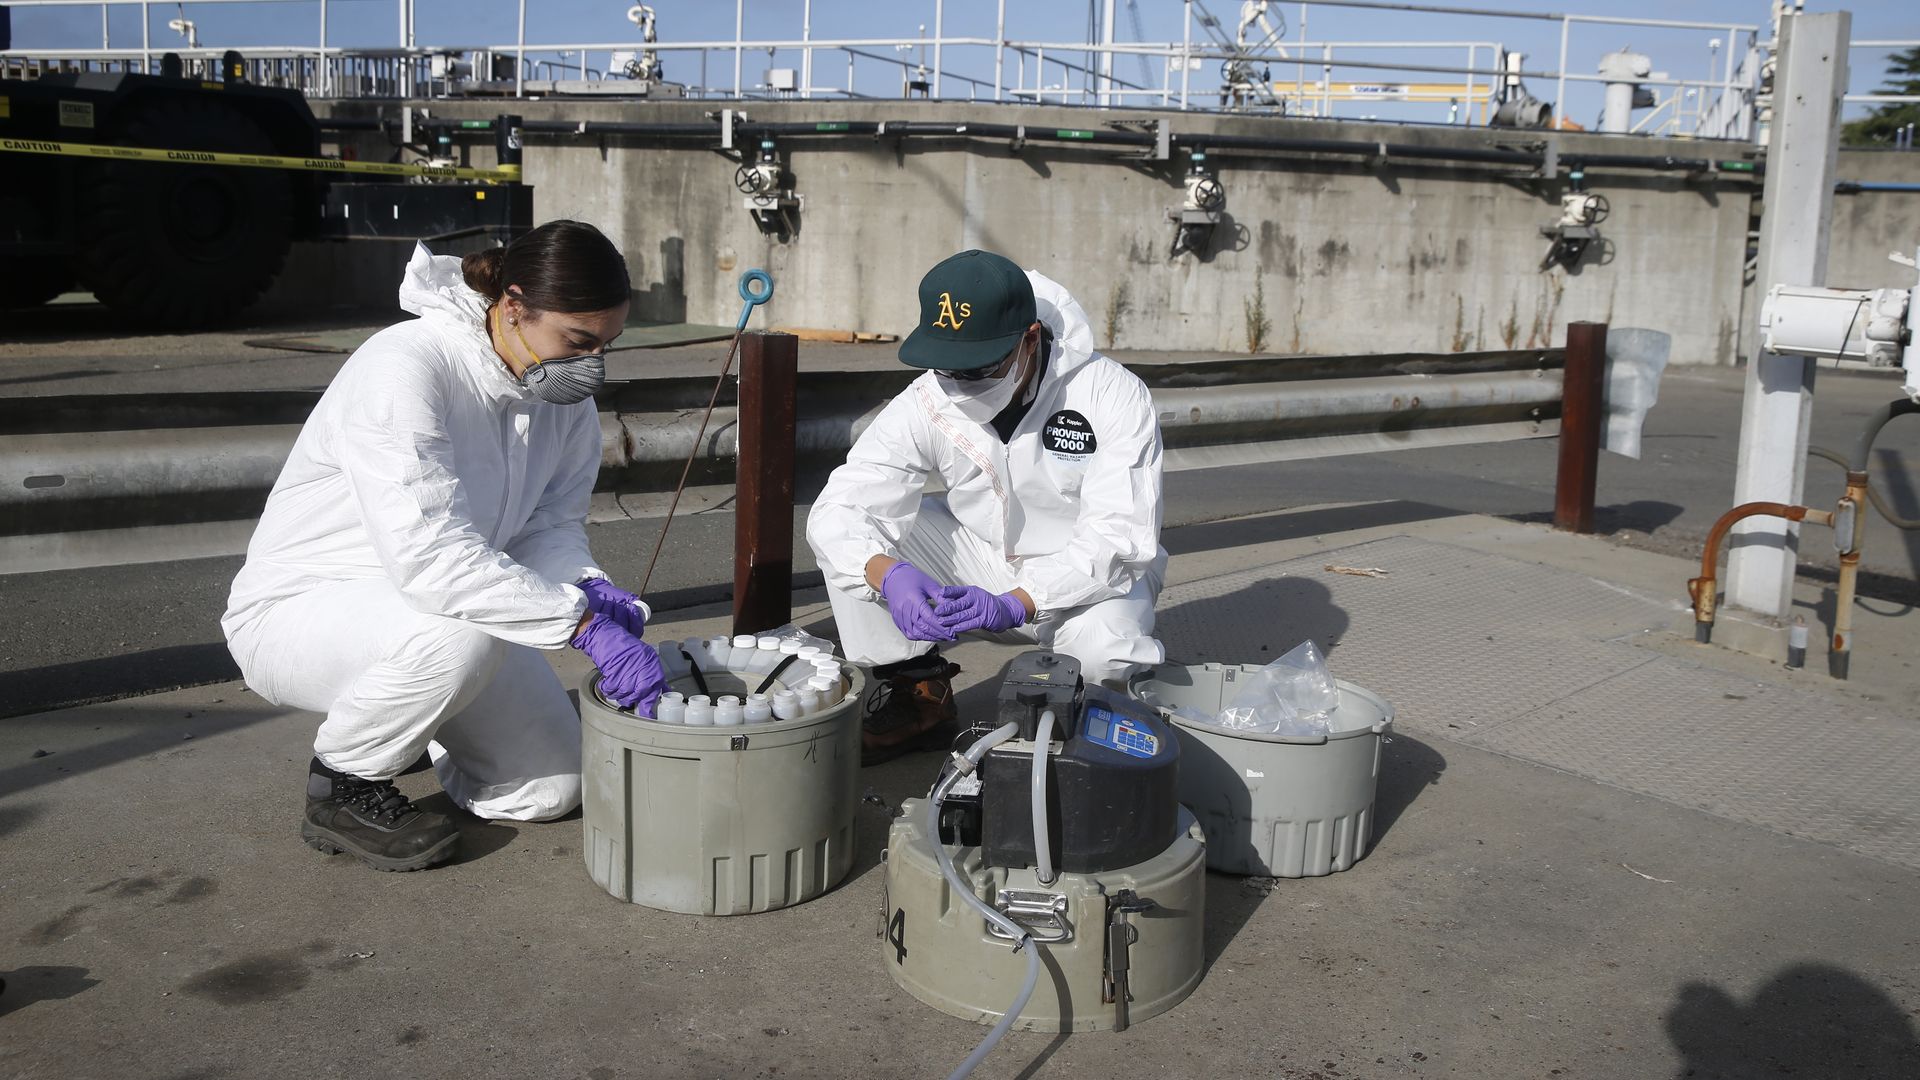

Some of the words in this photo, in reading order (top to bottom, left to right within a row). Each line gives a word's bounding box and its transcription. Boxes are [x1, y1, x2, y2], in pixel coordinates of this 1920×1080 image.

[4, 141, 62, 152] CAUTION
[167, 151, 216, 162] CAUTION
[304, 160, 346, 169] CAUTION
[422, 167, 457, 176] CAUTION
[932, 292, 971, 331] A's
[1046, 426, 1093, 441] PROVENT
[1054, 437, 1085, 451] 7000
[889, 907, 907, 966] 4
